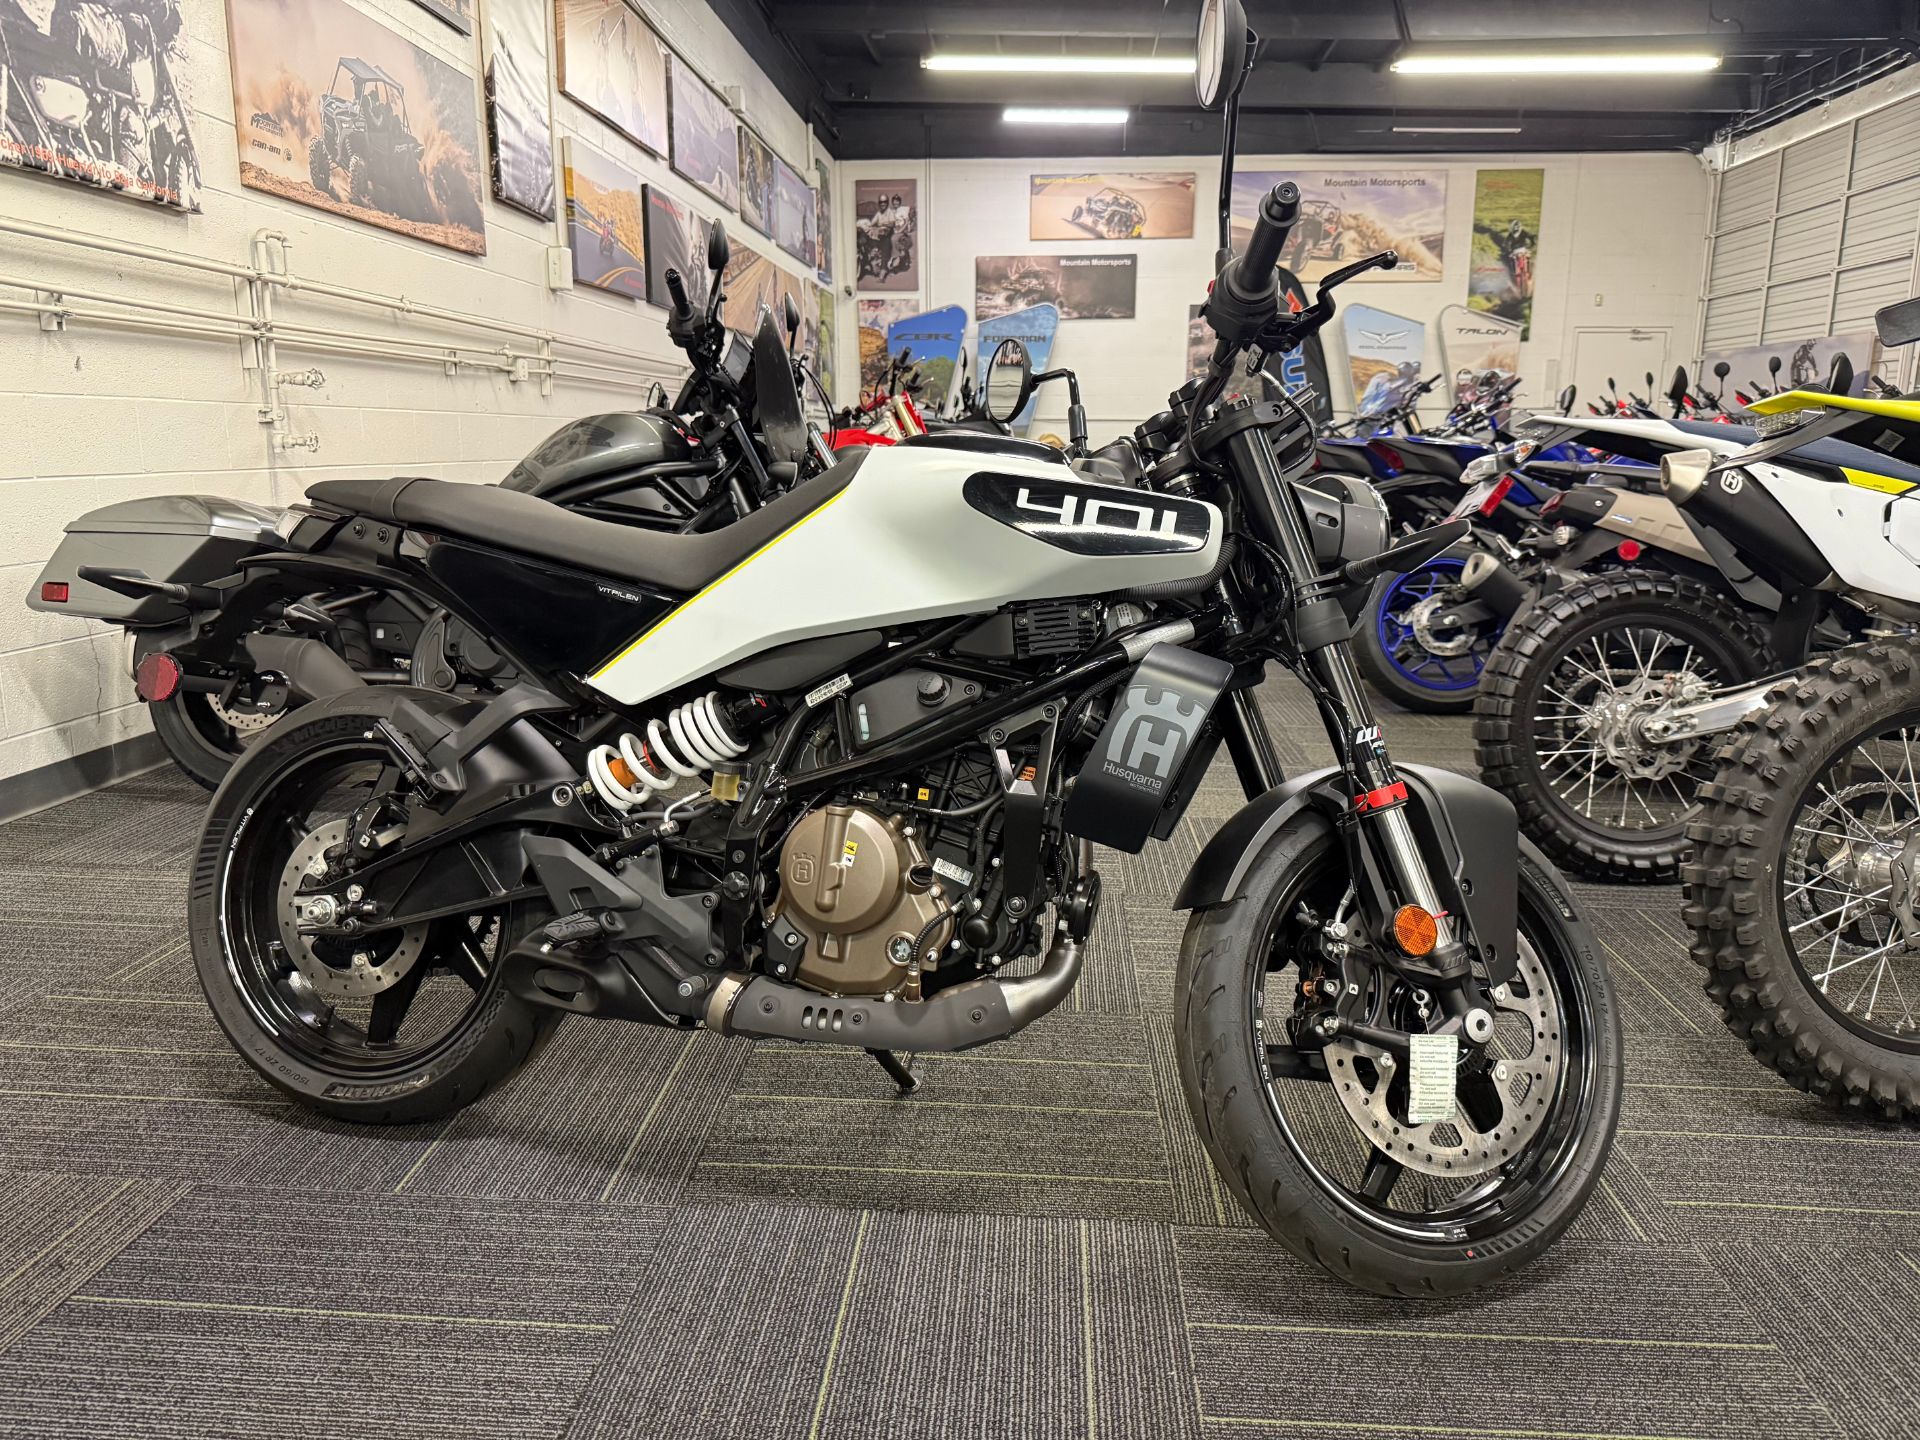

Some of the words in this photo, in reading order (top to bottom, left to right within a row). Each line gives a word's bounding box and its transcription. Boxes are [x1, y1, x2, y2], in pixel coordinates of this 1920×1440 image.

[252, 138, 281, 156] can-am
[1323, 178, 1368, 188] Mountain
[1369, 177, 1427, 189] Motorsports
[1060, 258, 1091, 267] Mountain
[1091, 257, 1132, 268] Motorsports
[1456, 327, 1510, 336] TALON
[1016, 487, 1178, 536] 401
[598, 585, 640, 602] VITPILEN
[1102, 760, 1163, 790] Husqvarna
